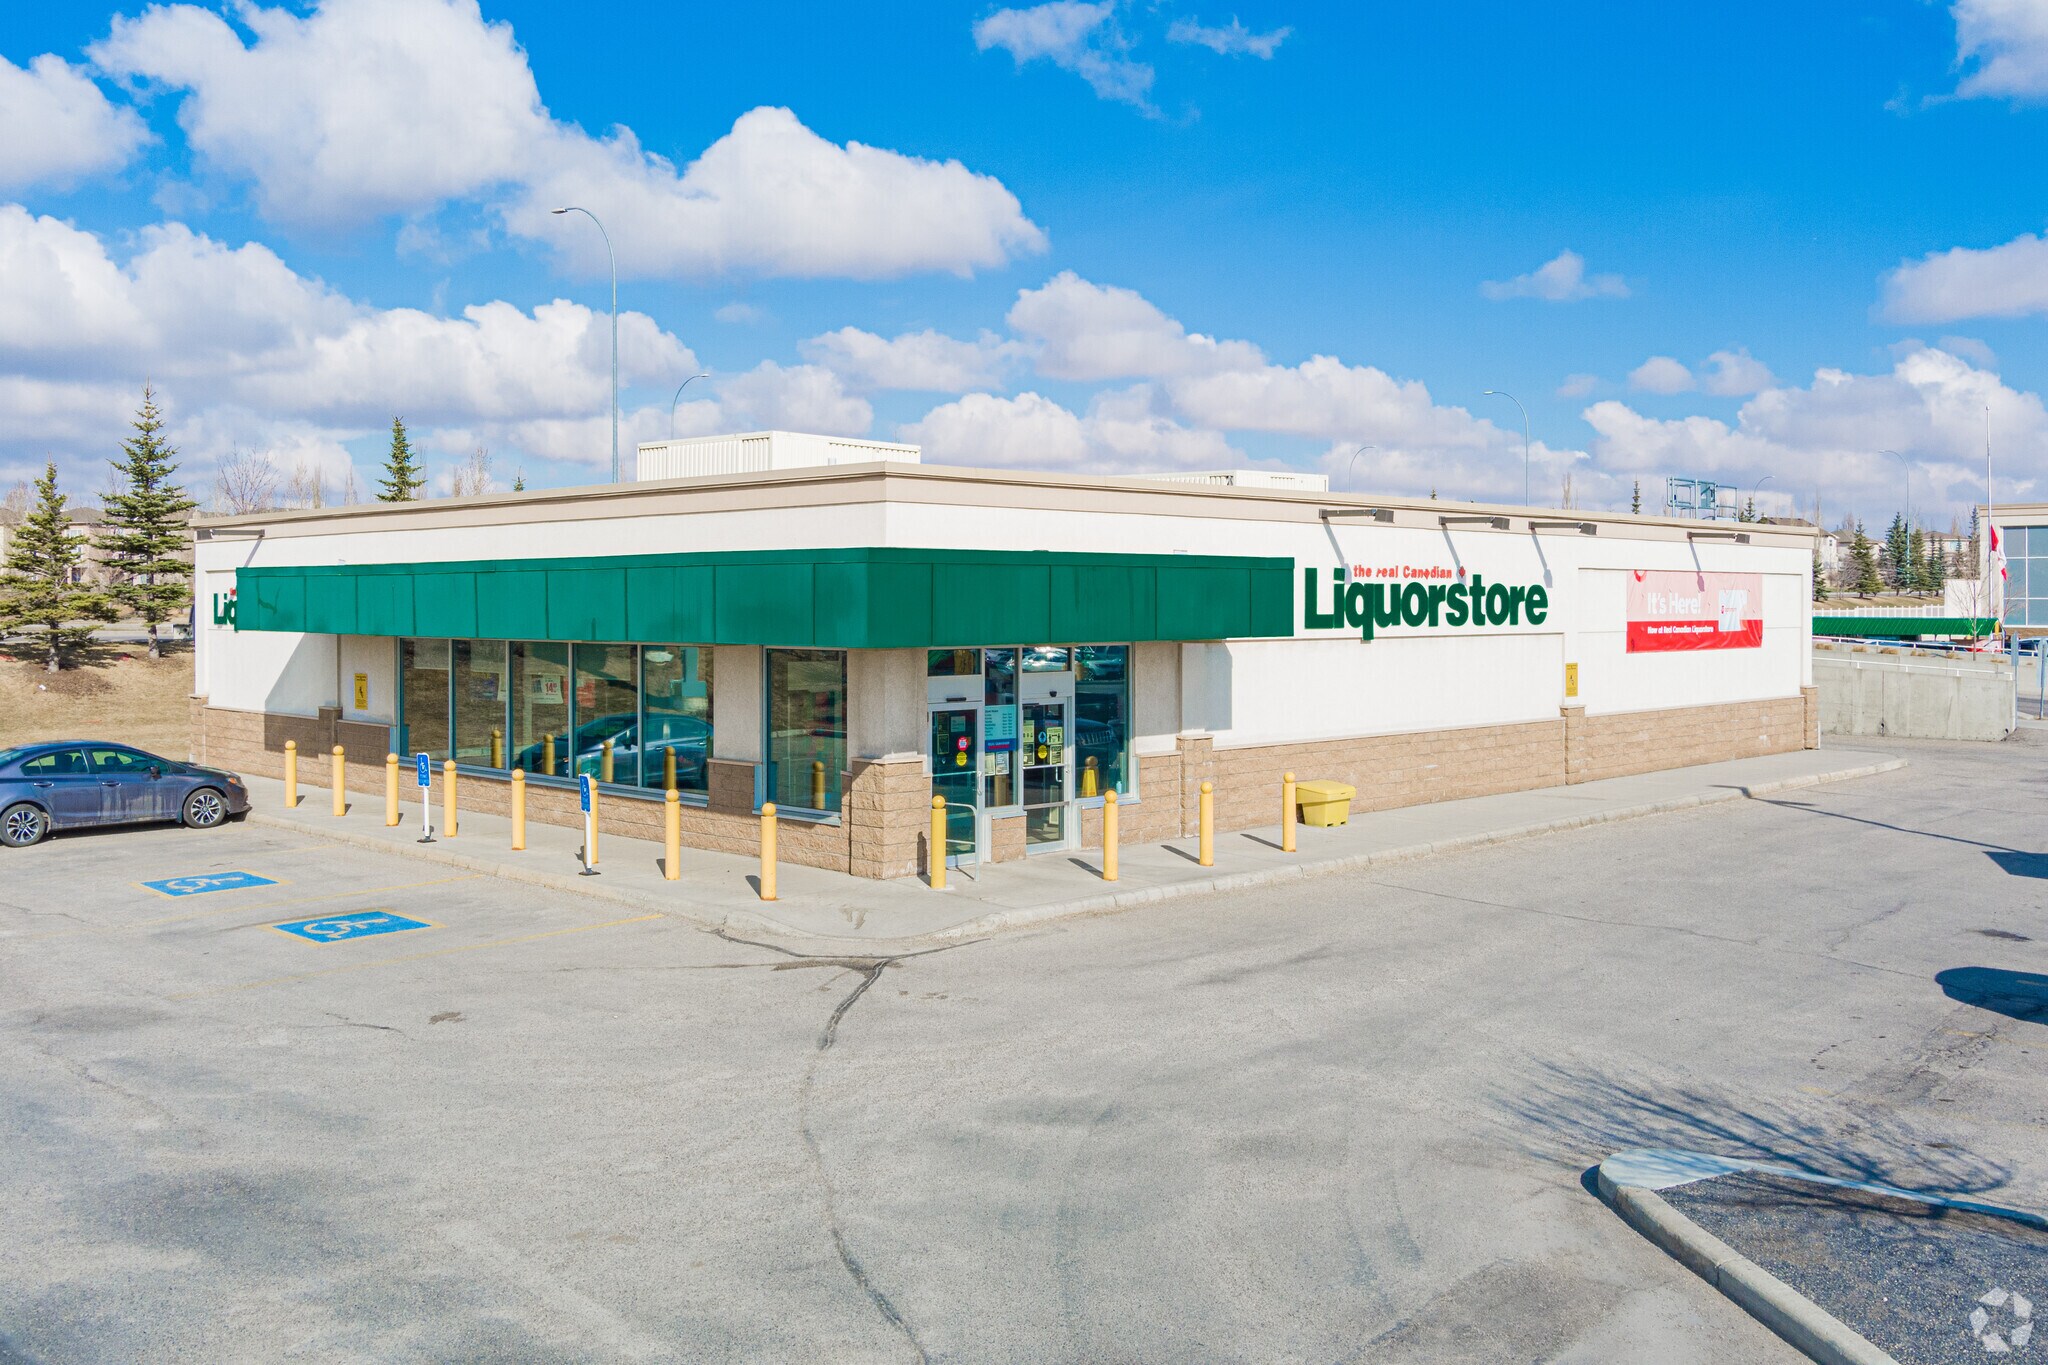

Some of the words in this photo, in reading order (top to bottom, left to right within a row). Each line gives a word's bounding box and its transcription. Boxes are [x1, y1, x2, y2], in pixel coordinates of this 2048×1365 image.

[1353, 565, 1372, 578] the
[1376, 565, 1399, 578] real
[1304, 567, 1549, 641] Liquorstore
